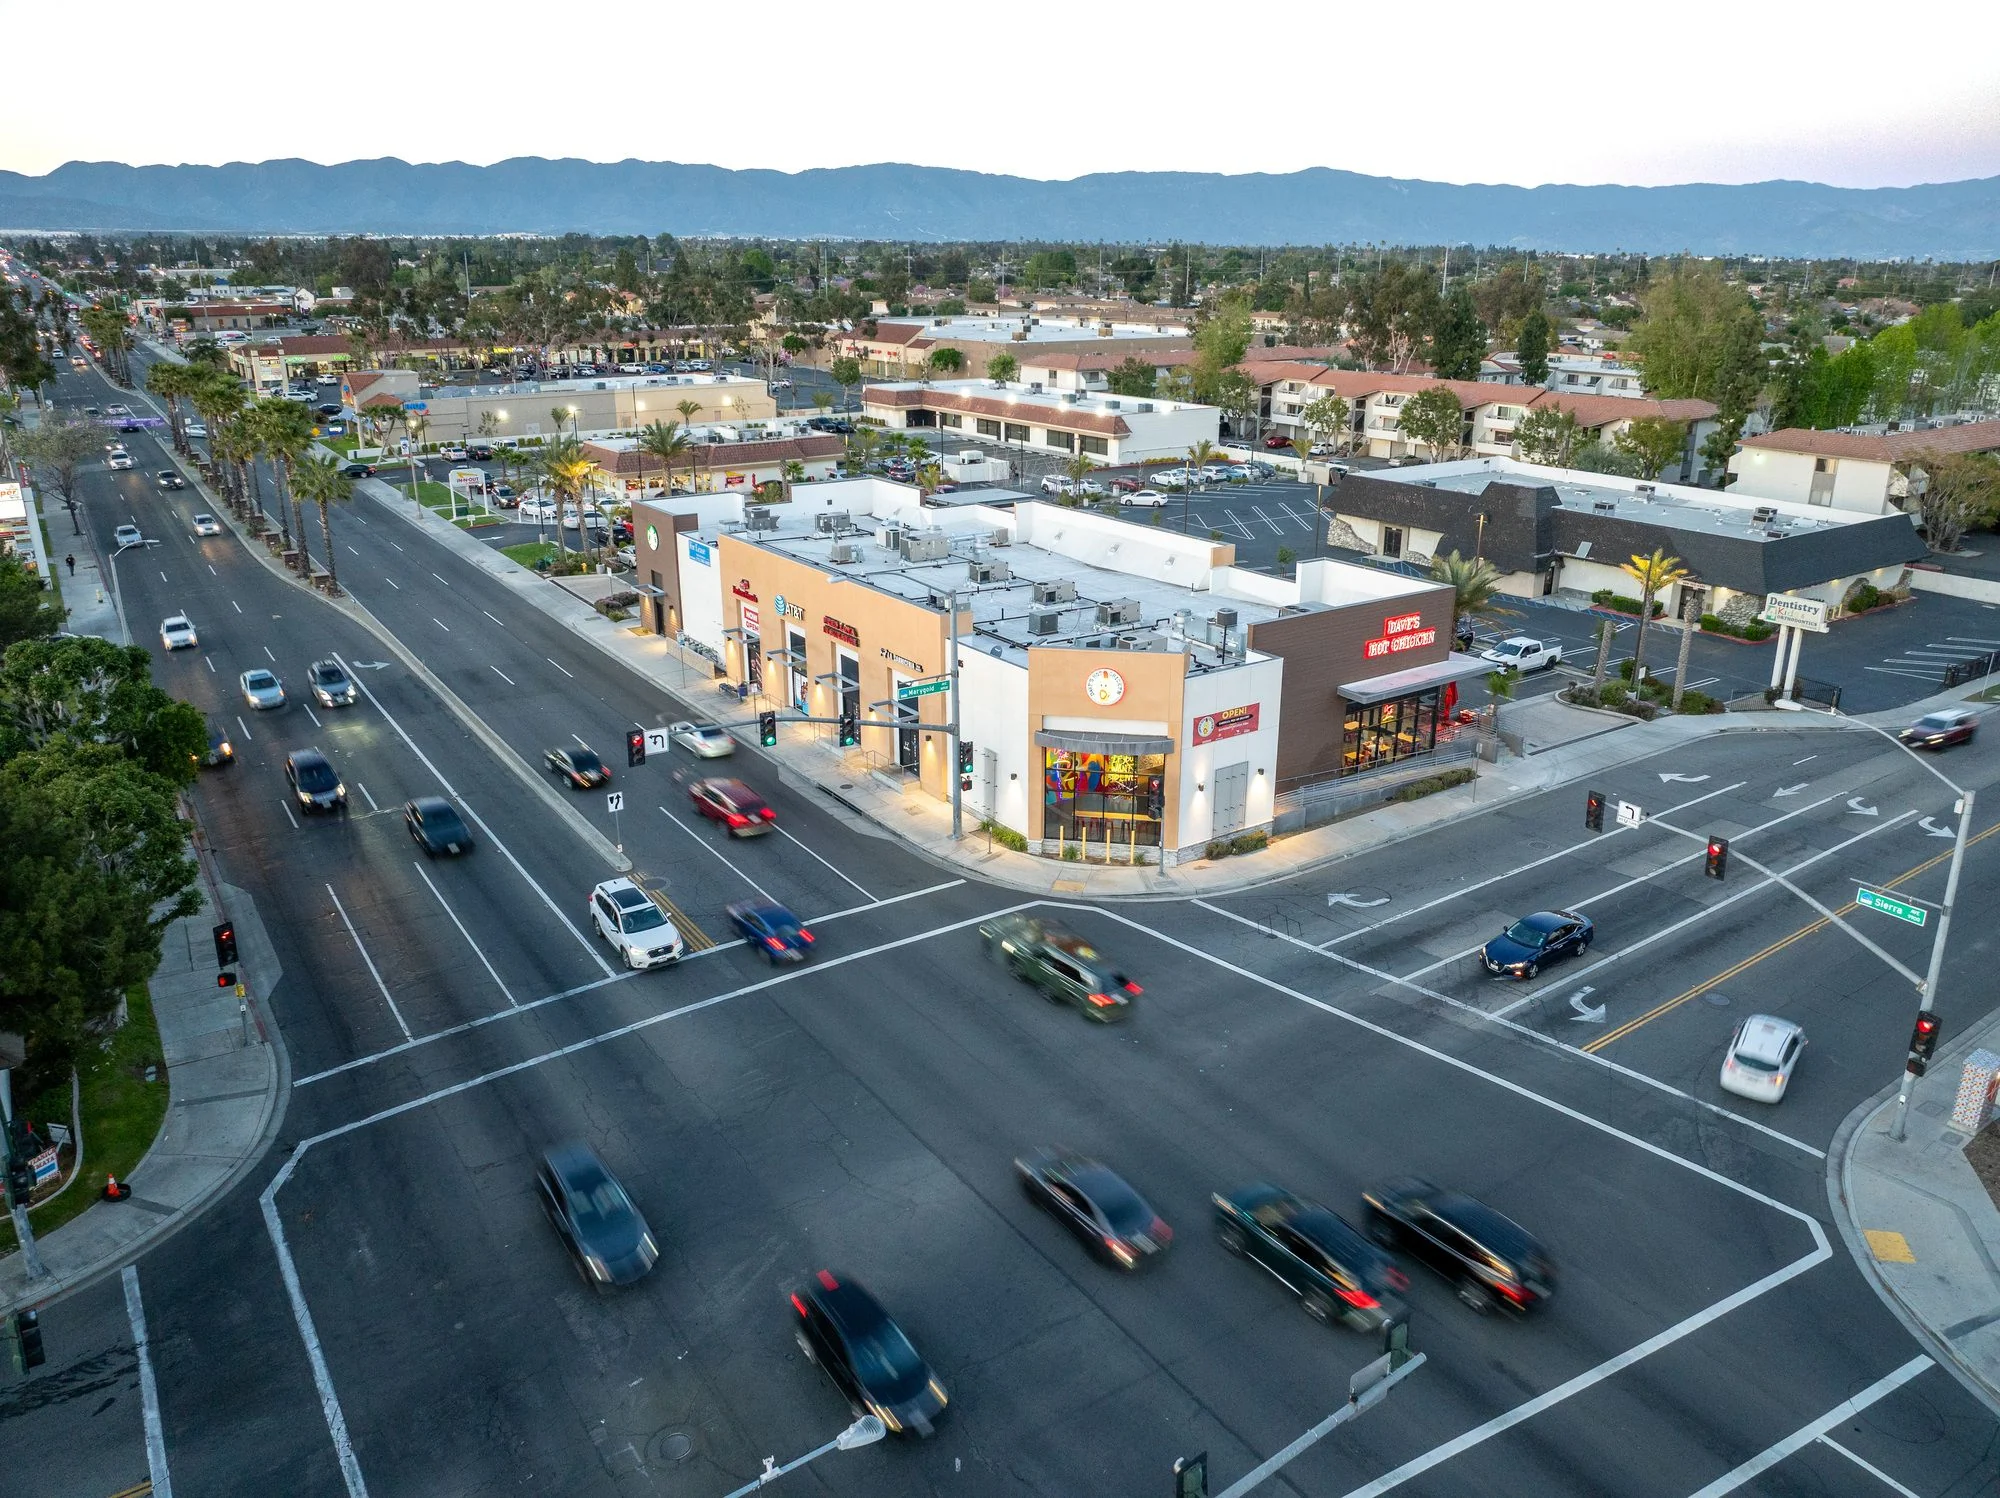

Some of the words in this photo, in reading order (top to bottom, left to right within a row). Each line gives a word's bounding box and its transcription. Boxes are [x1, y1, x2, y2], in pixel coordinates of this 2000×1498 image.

[786, 602, 804, 620] AT&T
[1769, 596, 1820, 615] Dentistry
[1387, 615, 1420, 634] DAVE'S
[1368, 640, 1391, 656] HOT
[1391, 630, 1436, 652] CHICKEN
[908, 685, 935, 696] Marygold
[1221, 706, 1248, 720] OPEN!
[1874, 898, 1903, 915] Sierra
